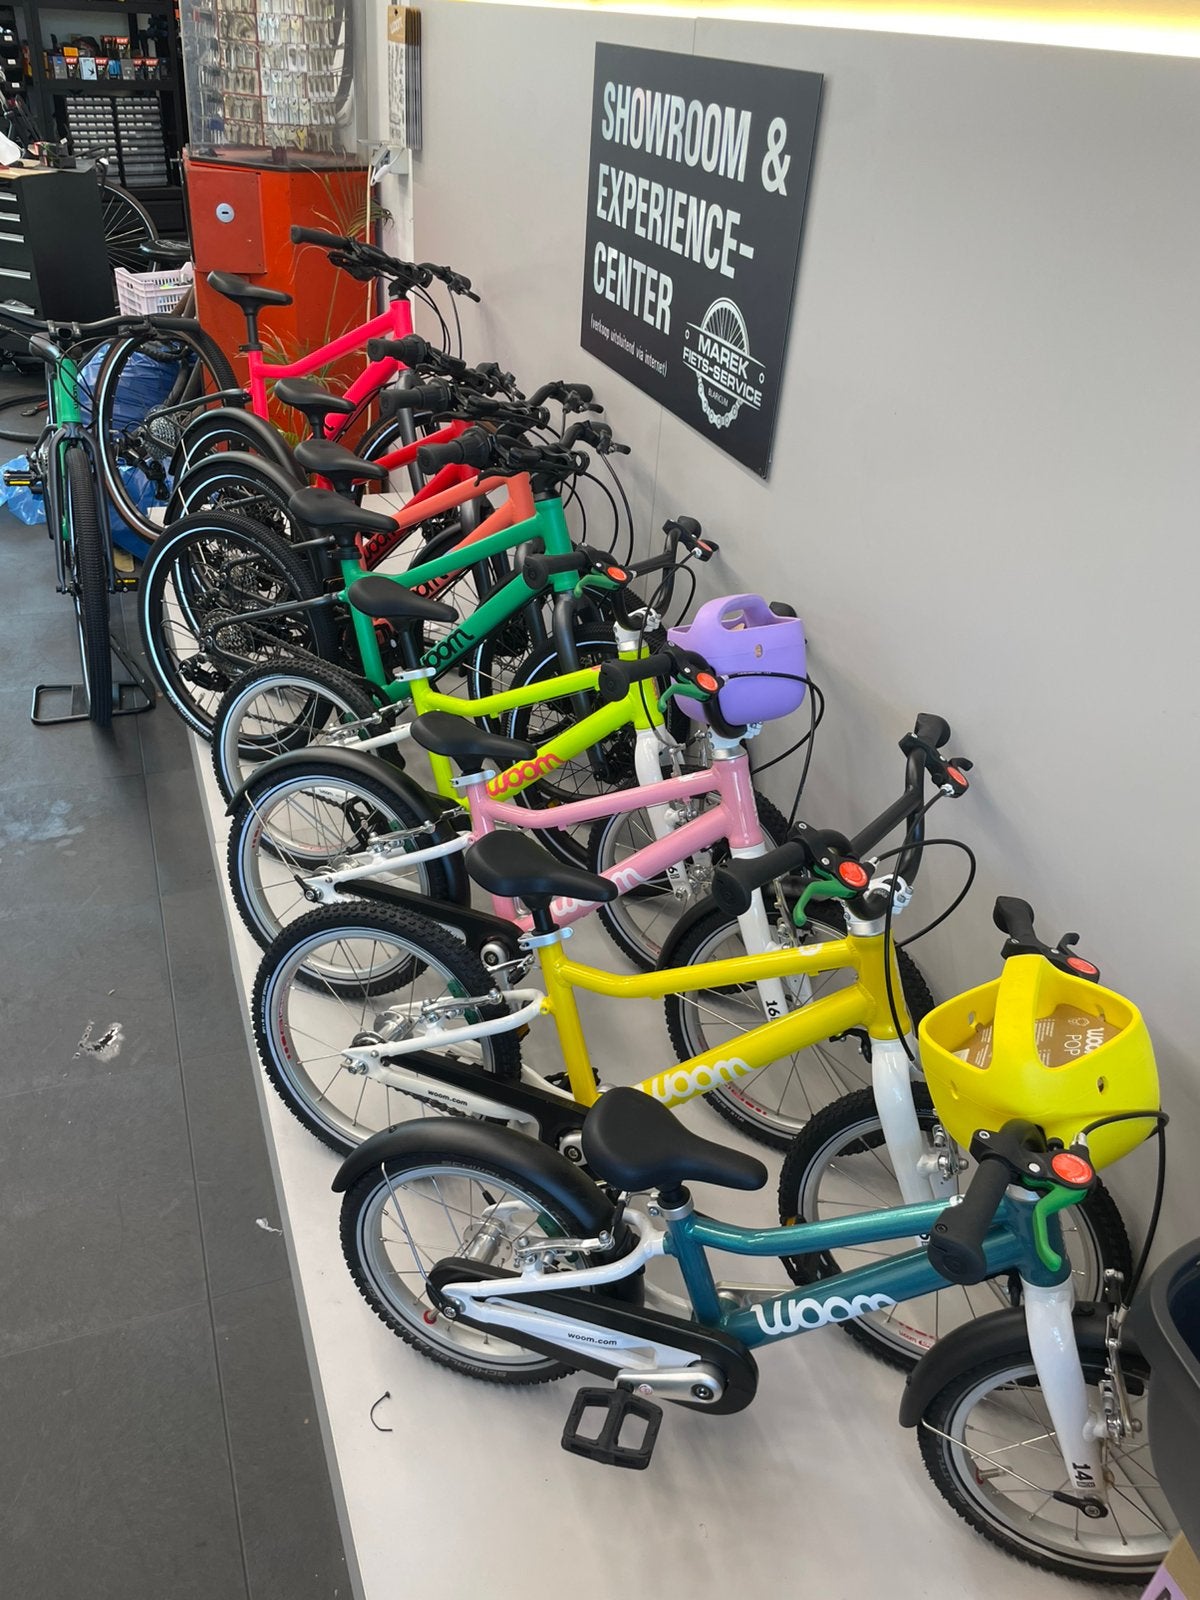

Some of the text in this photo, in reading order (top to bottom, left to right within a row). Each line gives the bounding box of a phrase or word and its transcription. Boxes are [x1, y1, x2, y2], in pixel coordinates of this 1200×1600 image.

[601, 81, 791, 196] SHOWROOM &
[597, 163, 754, 279] EXPERIENCE-
[593, 241, 673, 335] CENTER
[636, 345, 644, 361] via
[644, 349, 668, 377] internet)
[682, 346, 763, 407] FIETS-SERVICE
[698, 334, 750, 379] MAREK
[420, 628, 475, 669] oom
[485, 753, 566, 797] woom
[765, 1000, 781, 1017] 16
[1063, 1034, 1083, 1056] POP
[1084, 1027, 1104, 1054] woo
[427, 1090, 468, 1106] woom.com
[750, 1293, 898, 1336] woom
[567, 1333, 618, 1346] woom.com
[1072, 1462, 1094, 1480] 14
